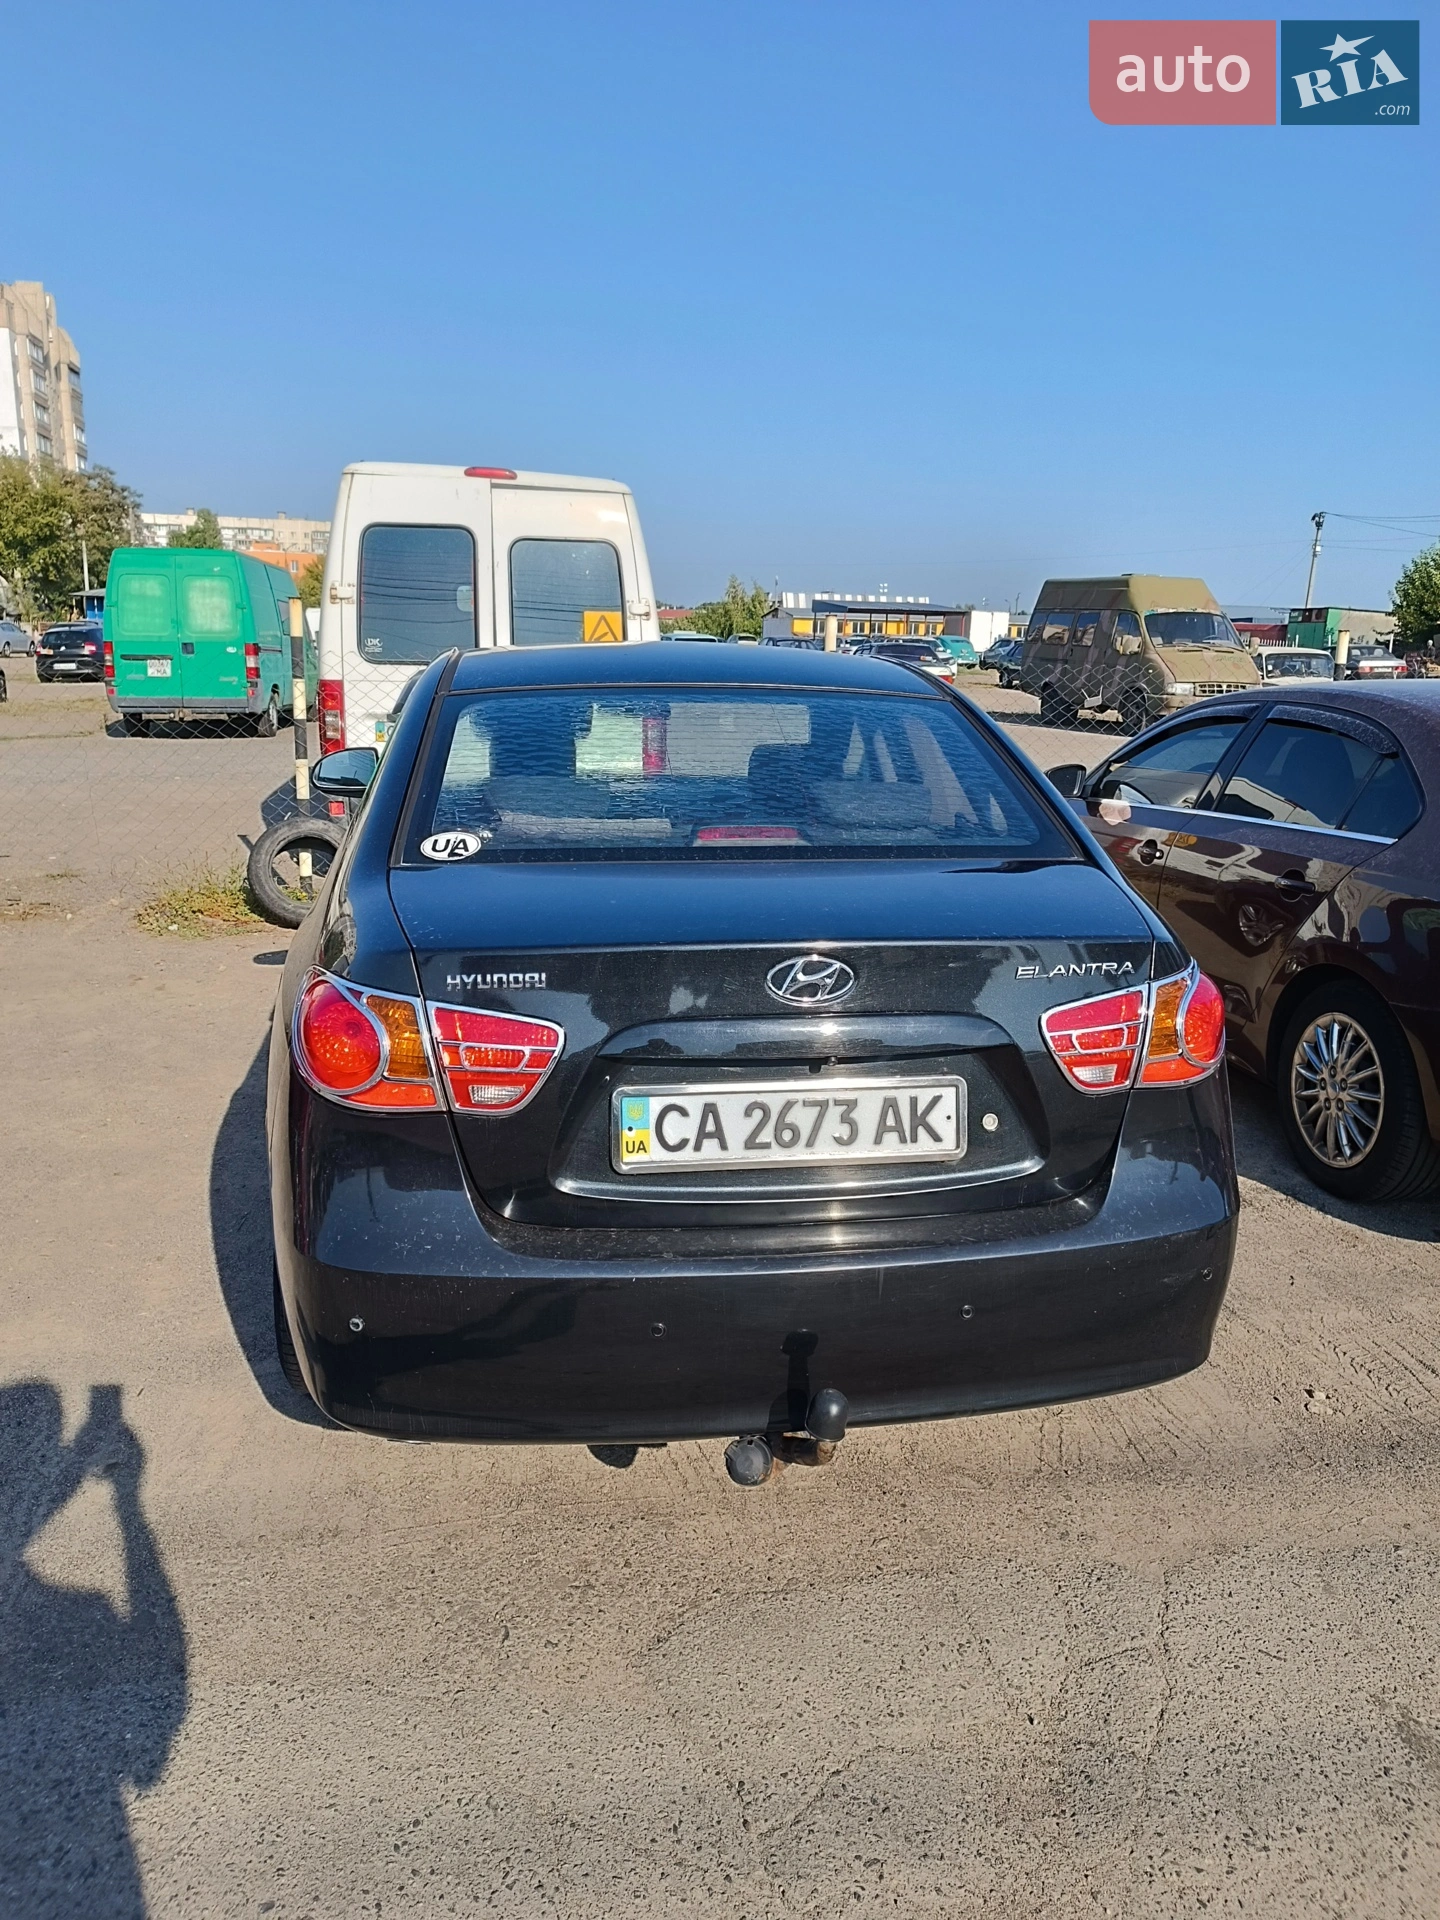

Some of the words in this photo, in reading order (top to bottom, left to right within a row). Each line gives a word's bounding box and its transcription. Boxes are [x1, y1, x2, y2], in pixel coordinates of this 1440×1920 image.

[431, 838, 470, 853] UA
[1015, 961, 1135, 980] ELANTRA
[446, 972, 546, 991] HYUNDAI
[654, 1102, 729, 1154] CA
[744, 1097, 858, 1150] 2673
[873, 1093, 944, 1146] AK
[625, 1140, 648, 1155] UA
